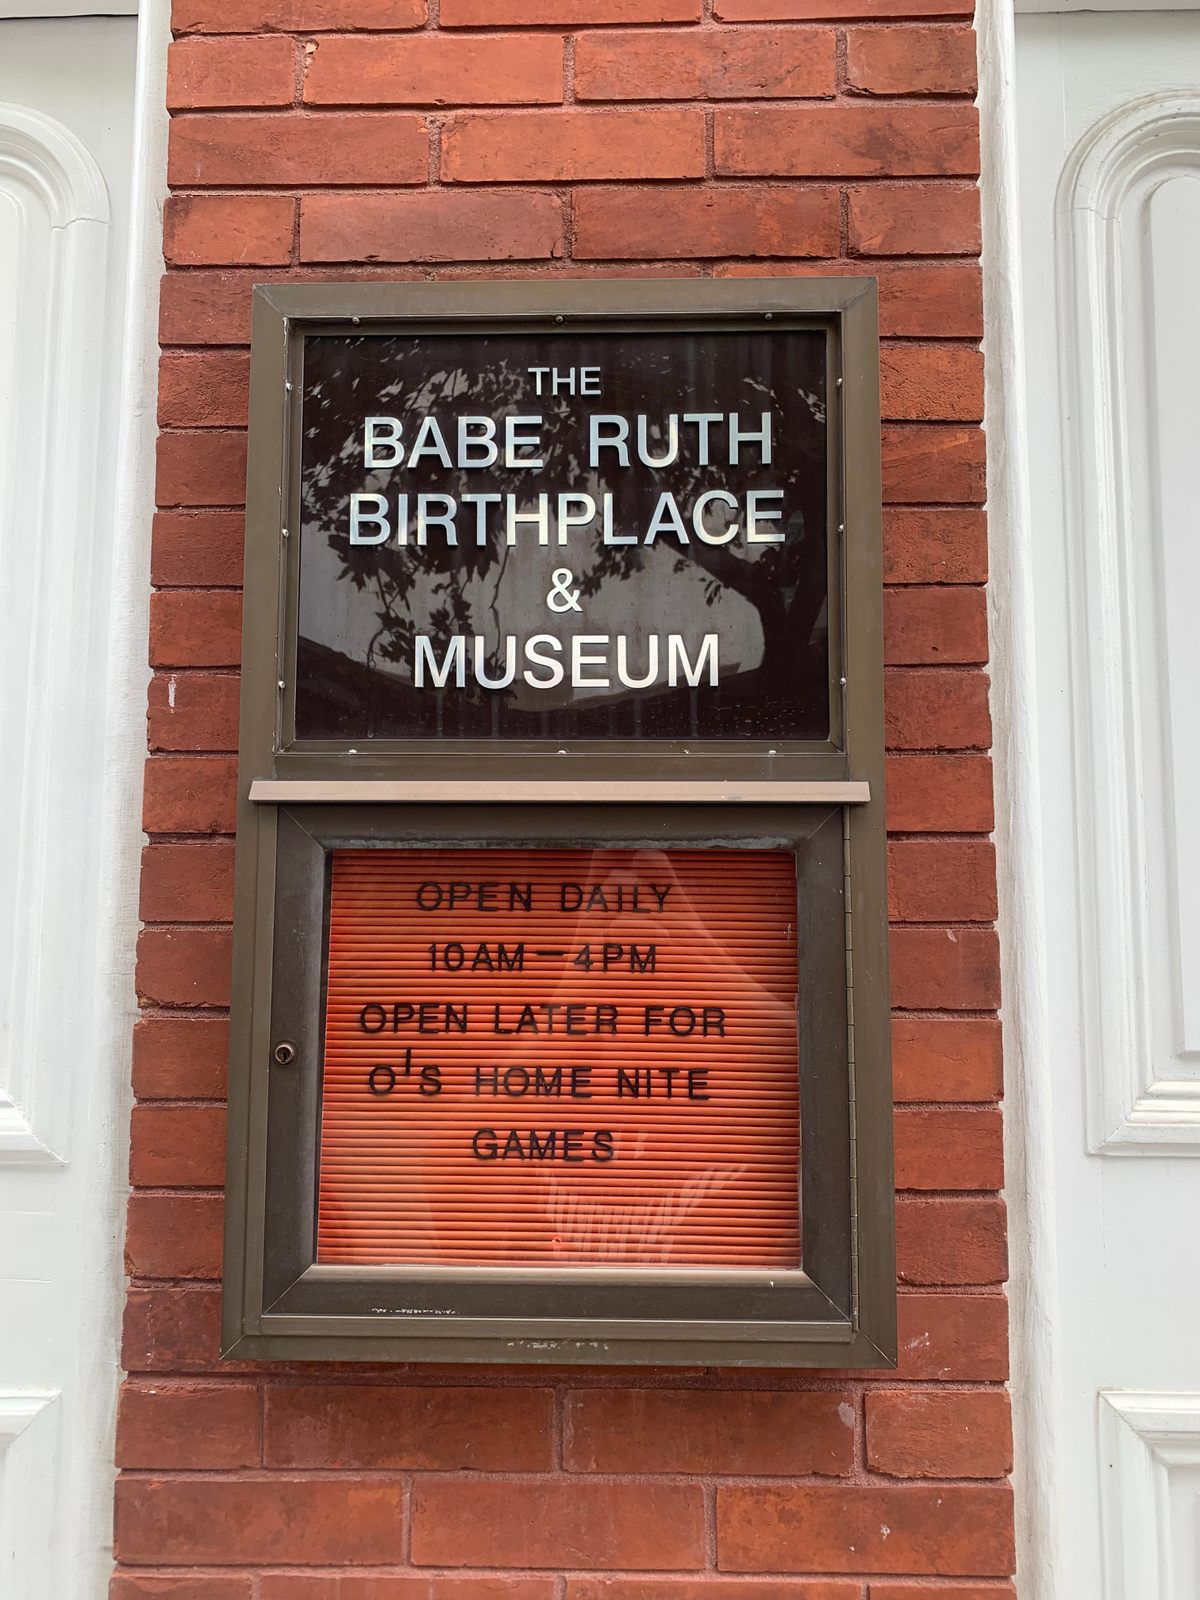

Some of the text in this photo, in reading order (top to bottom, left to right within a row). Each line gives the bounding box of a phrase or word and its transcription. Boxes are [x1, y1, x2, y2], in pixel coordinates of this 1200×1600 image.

[528, 367, 601, 396] THE
[364, 412, 772, 469] BABE RUTH
[349, 489, 785, 546] BIRTHPLACE
[546, 568, 583, 613] &
[415, 634, 719, 689] MUSEUM
[416, 882, 671, 913] OPEN DAILY
[359, 1003, 726, 1036] OPEN LATER FOR
[475, 1066, 592, 1098] HOME
[618, 1068, 710, 1100] NITE
[472, 1128, 614, 1161] GAMES
